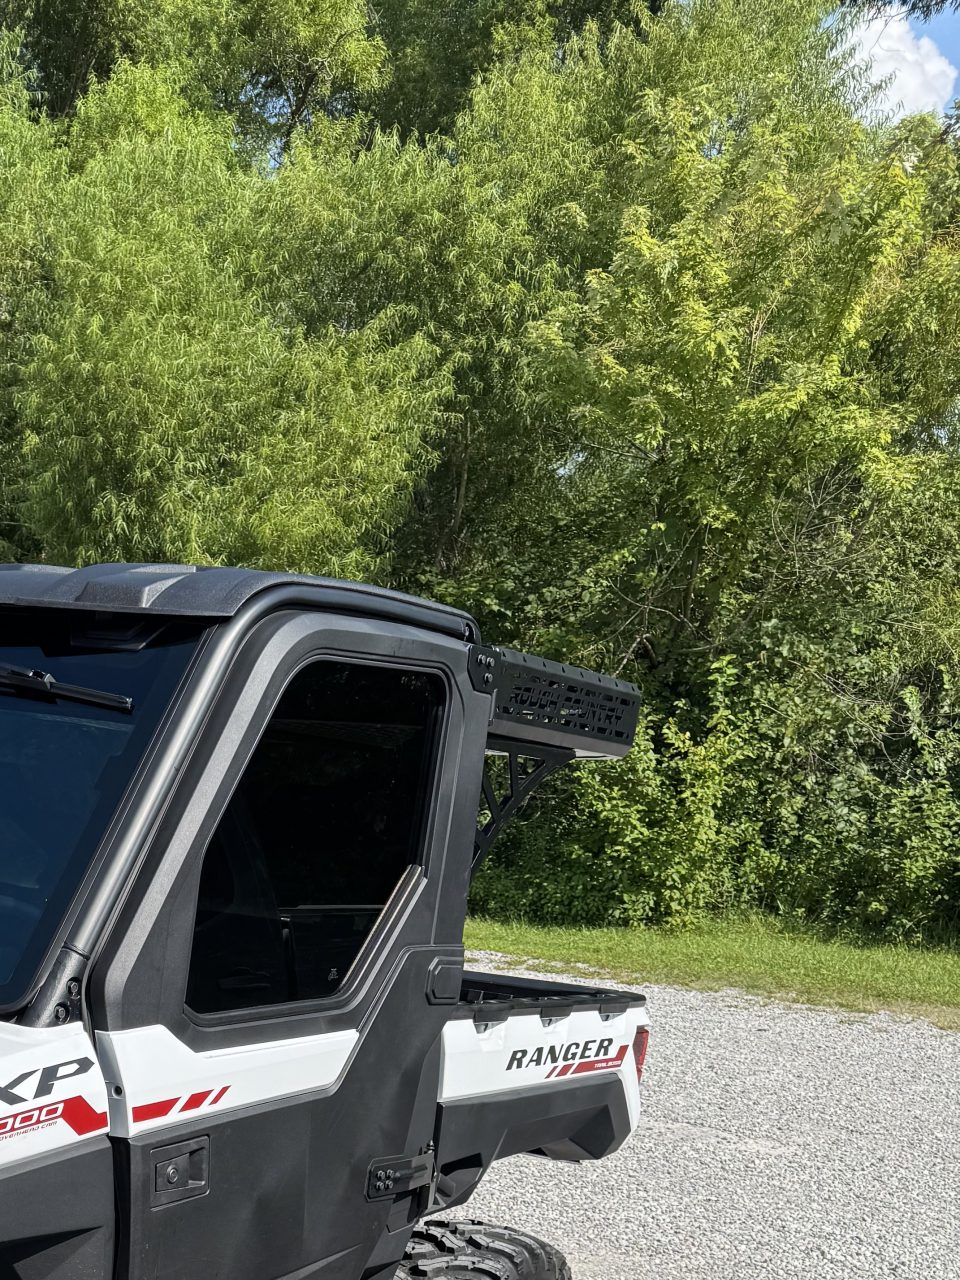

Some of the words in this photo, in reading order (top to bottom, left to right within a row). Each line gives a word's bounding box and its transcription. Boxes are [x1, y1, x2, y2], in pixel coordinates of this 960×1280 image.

[509, 686, 561, 713] ROUGH
[559, 696, 624, 725] COUNTRY
[506, 1038, 614, 1071] RANGER
